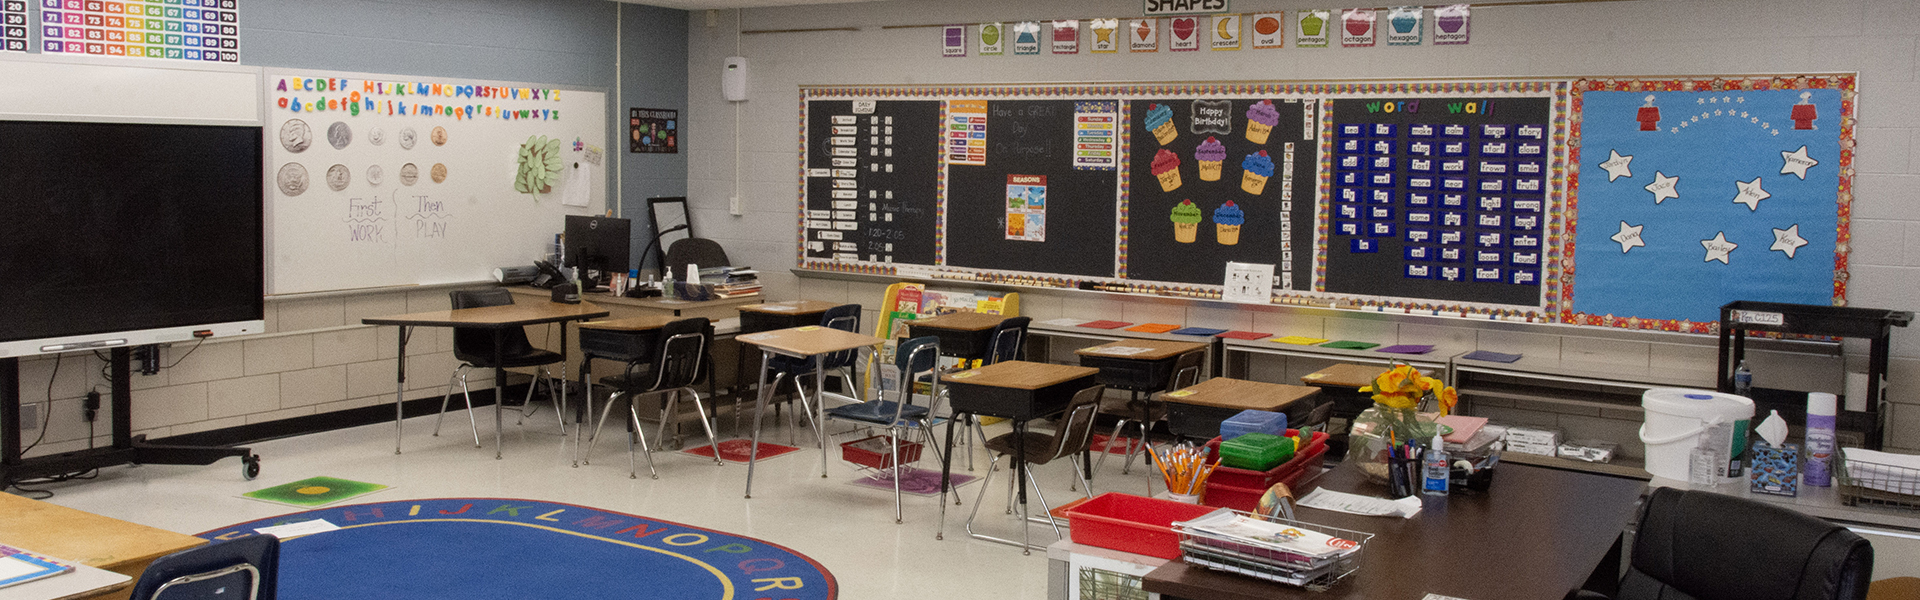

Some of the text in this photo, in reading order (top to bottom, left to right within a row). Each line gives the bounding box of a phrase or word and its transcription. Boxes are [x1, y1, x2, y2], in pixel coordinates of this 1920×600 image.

[8, 3, 22, 11] 20
[222, 0, 234, 8] 60
[1148, 0, 1225, 12] SHAPES
[67, 1, 80, 9] 62
[88, 2, 100, 10] 63
[108, 4, 121, 12] 64
[148, 7, 160, 15] 66
[186, 10, 197, 18] 68
[204, 11, 216, 19] 69
[222, 13, 234, 21] 70
[8, 16, 22, 24] 30
[67, 15, 80, 23] 72
[88, 17, 100, 25] 73
[109, 18, 121, 26] 74
[149, 21, 160, 29] 76
[186, 24, 198, 32] 78
[205, 25, 216, 33] 79
[223, 26, 234, 34] 80
[47, 28, 58, 36] 81
[88, 31, 101, 39] 83
[109, 32, 122, 40] 84
[149, 35, 161, 43] 86
[168, 36, 179, 44] 87
[186, 37, 198, 45] 88
[48, 42, 59, 50] 91
[68, 44, 81, 52] 92
[89, 45, 102, 53] 93
[109, 46, 122, 54] 94
[129, 47, 141, 55] 95
[149, 48, 161, 56] 96
[187, 51, 198, 59] 98
[205, 52, 217, 60] 99
[222, 53, 237, 61] 100
[1017, 44, 1036, 52] triangle
[993, 104, 1013, 117] Have
[1200, 107, 1224, 117] Happy
[1366, 99, 1494, 116] word wall
[1194, 118, 1228, 127] Birthday!
[1413, 126, 1431, 134] make
[1446, 125, 1463, 134] calm
[1486, 125, 1504, 138] large
[1520, 126, 1541, 138] story
[1376, 142, 1388, 153] shy
[1413, 143, 1429, 154] stop
[1447, 143, 1461, 152] real
[1484, 143, 1505, 153] start
[1520, 144, 1539, 153] close
[1413, 160, 1429, 169] fast
[1444, 161, 1462, 170] work
[1482, 162, 1505, 172] frown
[1520, 162, 1538, 172] smile
[1375, 175, 1389, 183] wet
[1483, 180, 1501, 190] small
[1518, 180, 1538, 189] truth
[1411, 194, 1427, 203] love
[349, 195, 382, 218] First
[411, 195, 444, 213] Then
[1515, 203, 1539, 212] wrong
[1374, 207, 1387, 217] low
[1446, 212, 1460, 225] play
[1481, 215, 1499, 225] first
[1516, 216, 1535, 229] laugh
[349, 224, 385, 243] WORK
[416, 219, 447, 239] PLAY
[1376, 224, 1388, 233] far
[1410, 232, 1427, 241] open
[1443, 232, 1460, 244] push
[1481, 234, 1499, 246] right
[1515, 236, 1536, 245] enter
[1479, 251, 1498, 261] loose
[1514, 253, 1536, 264] found
[1410, 266, 1427, 276] back
[1477, 269, 1498, 278] front
[1515, 271, 1532, 283] plain
[1754, 313, 1779, 323] C125
[439, 503, 472, 514] J
[487, 505, 533, 516] K
[535, 509, 565, 522] L
[615, 523, 667, 538] N
[663, 533, 709, 546] O
[704, 543, 753, 554] P
[737, 558, 785, 575] Q
[751, 576, 803, 591] R
